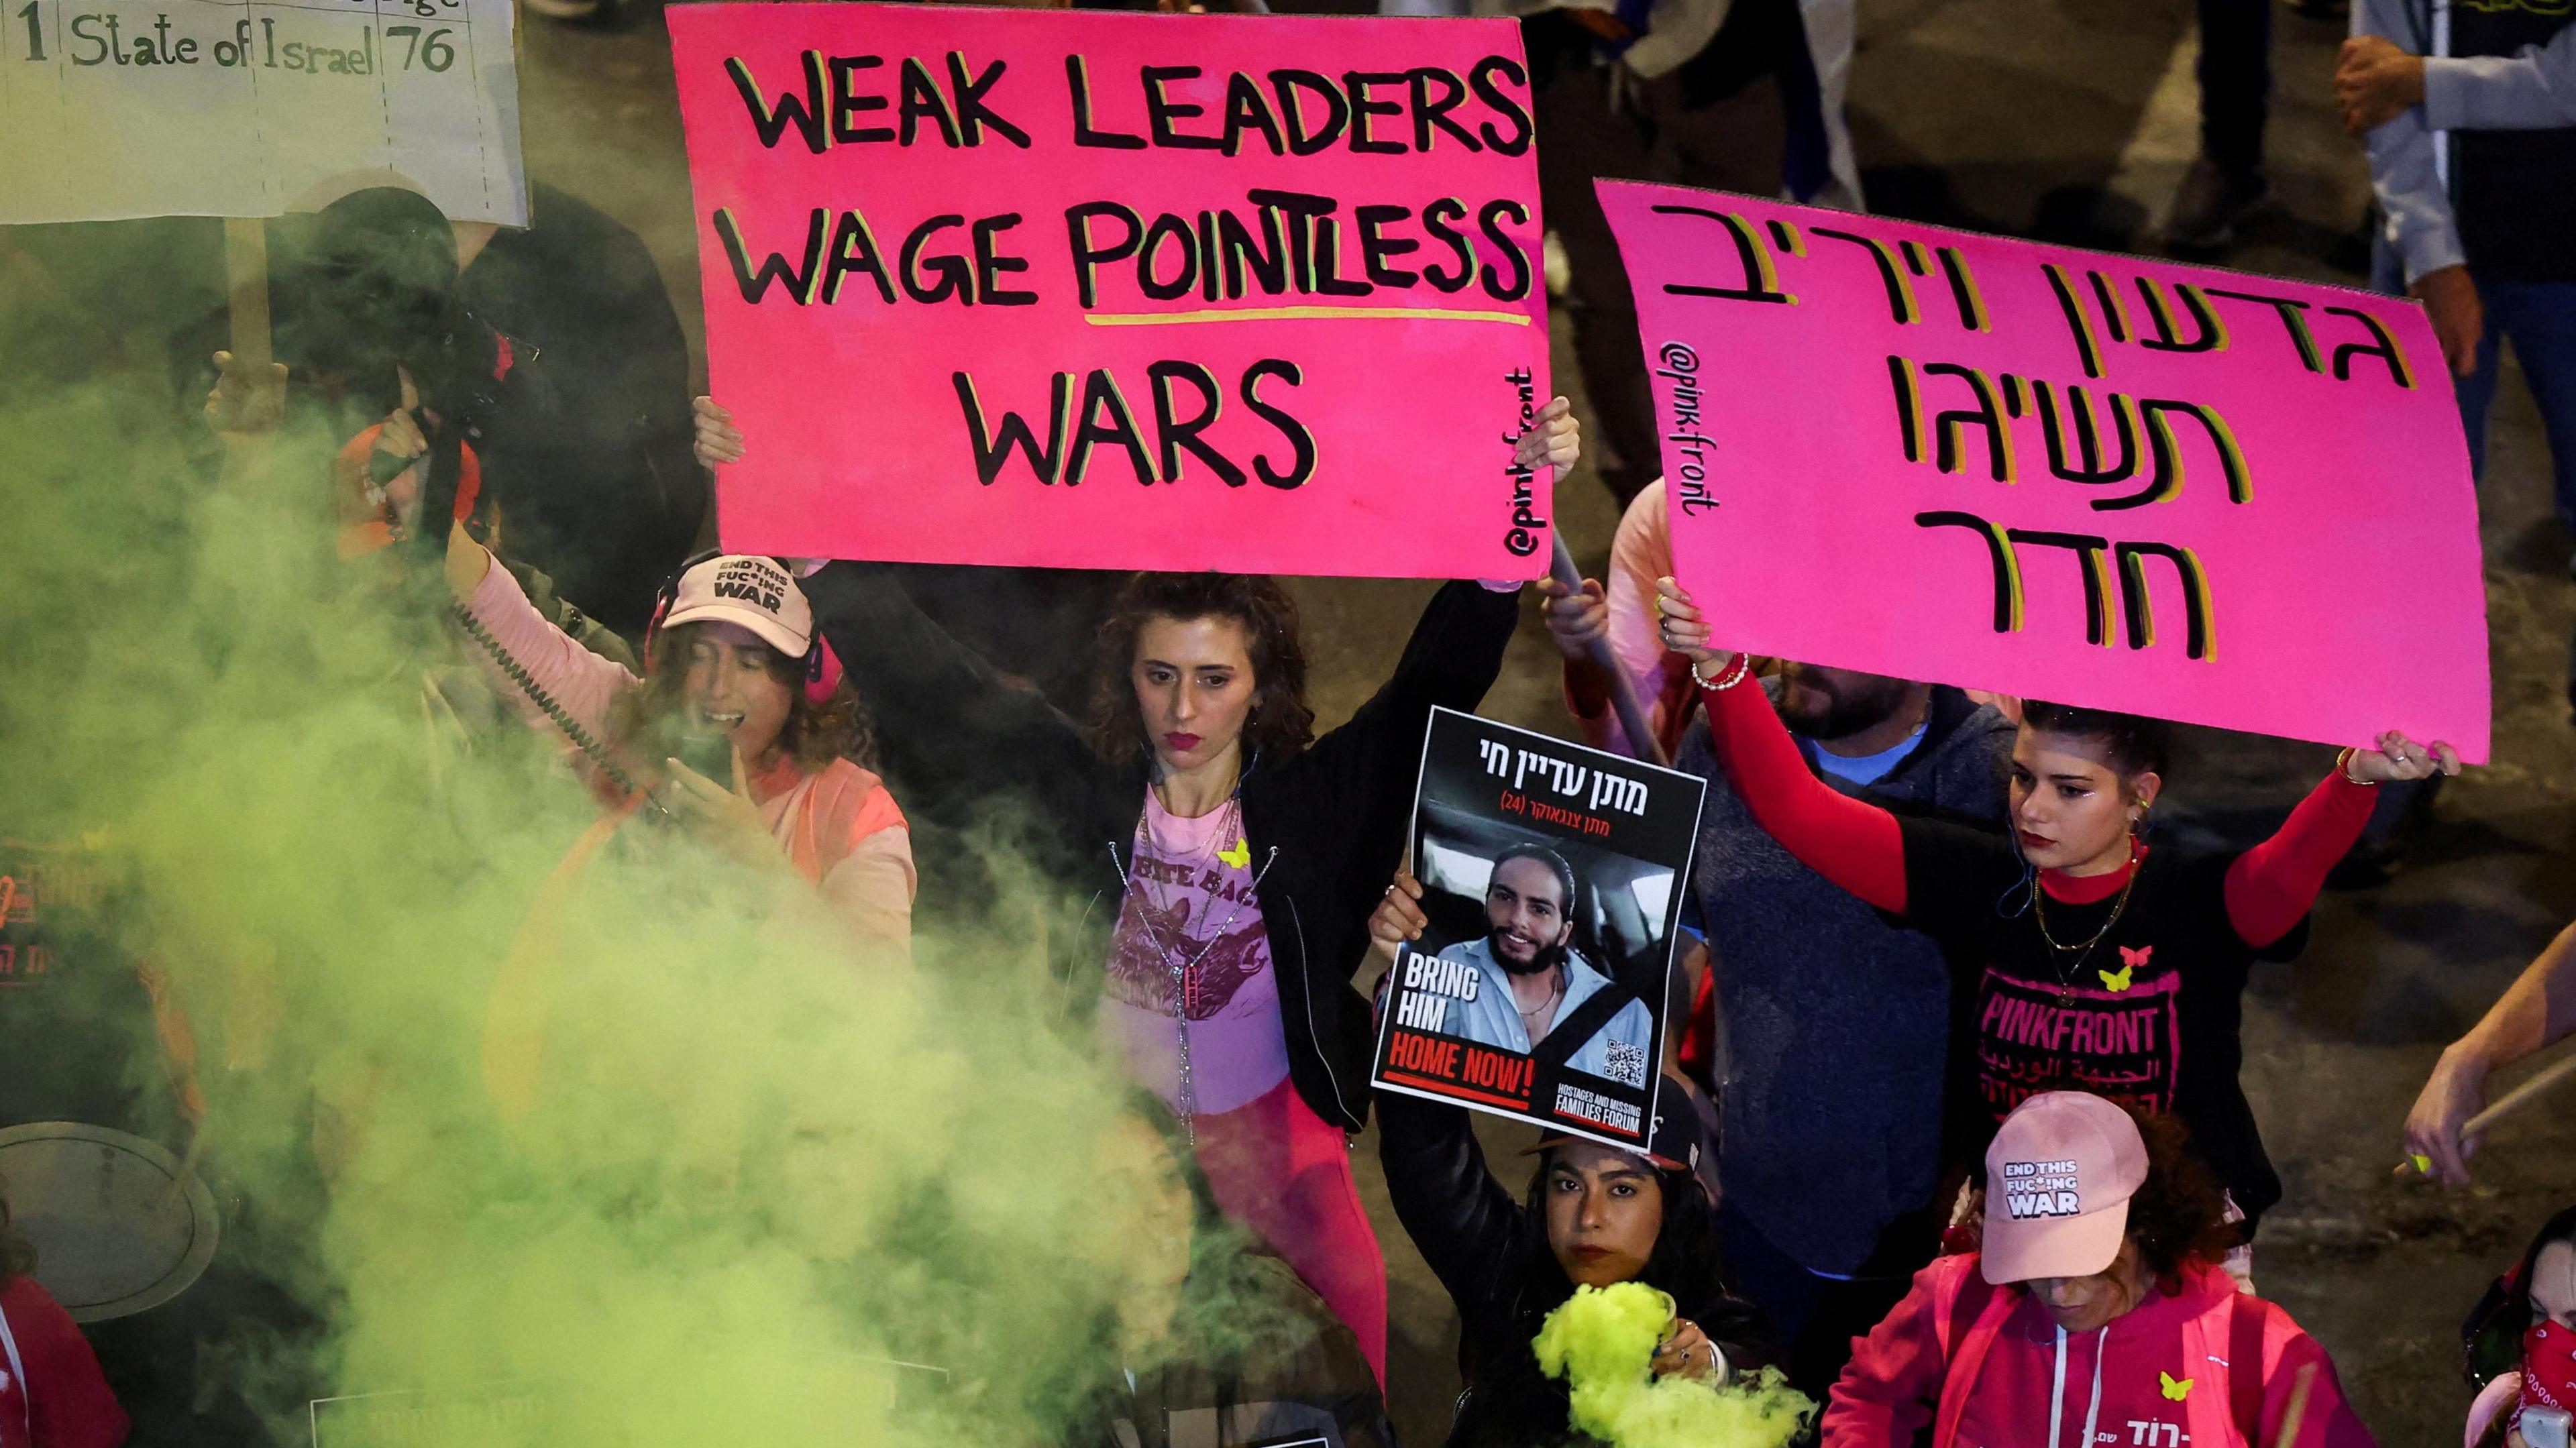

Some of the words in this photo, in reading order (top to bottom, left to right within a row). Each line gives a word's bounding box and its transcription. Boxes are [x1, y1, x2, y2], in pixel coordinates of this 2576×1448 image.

[17, 1, 47, 61] 1
[71, 13, 199, 66] State
[214, 19, 250, 67] of
[261, 18, 373, 74] Israel
[386, 26, 455, 72] 76
[723, 50, 1032, 154] WEAK
[1065, 54, 1536, 157] LEADERS
[713, 207, 1039, 307] WAGE
[1065, 188, 1532, 309] POINTLESS
[1651, 204, 1992, 333] ויריב
[2040, 264, 2418, 390] גדעון
[953, 358, 1318, 488] WARS
[1656, 341, 1720, 516] @pink.front
[1886, 355, 2253, 512] תשיגו
[714, 582, 781, 615] WAR
[719, 561, 752, 569] END
[755, 563, 788, 586] THIS
[1915, 510, 2217, 664] חדר
[1479, 738, 1509, 777] חי
[1513, 748, 1587, 797] עדיין
[1500, 790, 1527, 815] (24)
[1589, 771, 1648, 816] מתן
[1583, 816, 1610, 837] מתן
[1403, 951, 1479, 1002] BRING
[1396, 989, 1447, 1034] HIM
[1980, 991, 2159, 1054] PINKFRONT
[1389, 1031, 1458, 1078] HOME
[1462, 1047, 1536, 1097] NOW!
[1555, 1094, 1601, 1122] FAMILIES
[1602, 1109, 1640, 1133] FORUM
[1558, 1082, 1595, 1103] HOSTAGES
[1594, 1094, 1609, 1108] AND
[1609, 1099, 1642, 1117] MISSING
[2004, 1162, 2036, 1178] END
[2036, 1160, 2077, 1174] THIS
[2006, 1190, 2080, 1219] WAR
